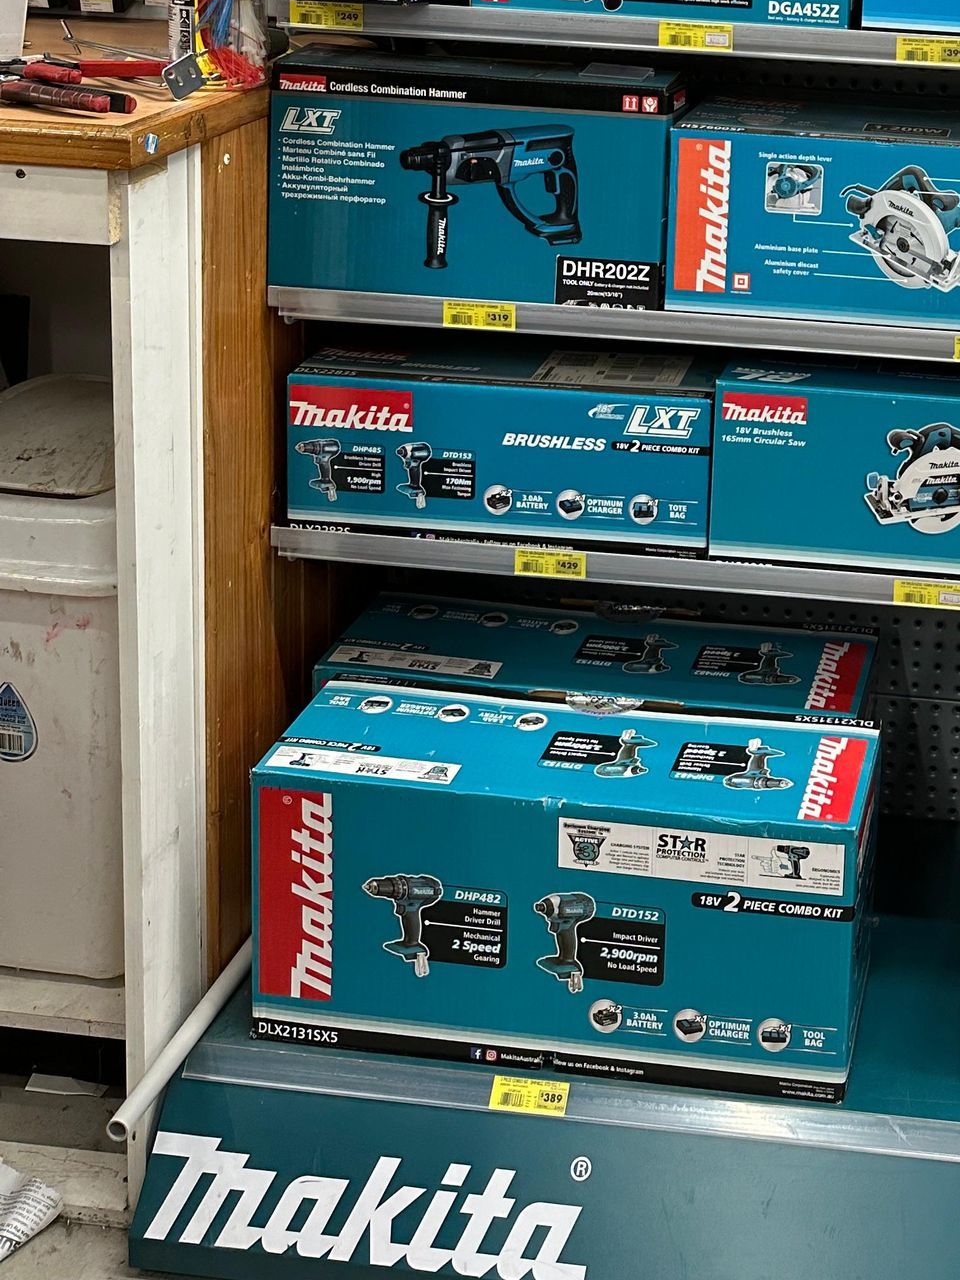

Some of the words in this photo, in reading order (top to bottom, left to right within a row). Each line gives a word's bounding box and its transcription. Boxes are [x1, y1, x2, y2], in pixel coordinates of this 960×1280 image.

[767, 1, 840, 19] DGA452Z
[330, 81, 369, 93] Cordless
[371, 84, 426, 97] Combination
[428, 87, 467, 100] Hammer
[278, 107, 341, 135] LXT
[562, 260, 650, 281] DHR202Z
[623, 405, 701, 439] LXT
[502, 433, 606, 452] BRUSHLESS
[721, 435, 752, 443] 165mm
[754, 436, 786, 445] Circular
[788, 438, 806, 447] Saw
[587, 499, 624, 508] OPTIMUM
[587, 506, 622, 515] CHARGER
[455, 891, 501, 904] DHP482
[700, 895, 722, 907] 18V
[723, 891, 741, 913] 2
[743, 901, 777, 913] PIECE
[779, 903, 821, 917] COMBO
[823, 906, 843, 918] KIT
[473, 908, 501, 917] Hammer
[611, 907, 659, 921] DTD152
[465, 916, 482, 924] Driver
[484, 917, 501, 925] Drill
[452, 940, 460, 949] 2
[463, 941, 500, 955] Speed
[600, 947, 658, 964] 2,900rpm
[258, 1022, 338, 1043] DLX2131SX5
[803, 1030, 826, 1040] TOOL
[804, 1038, 823, 1047] BAG
[541, 1093, 563, 1103] $389
